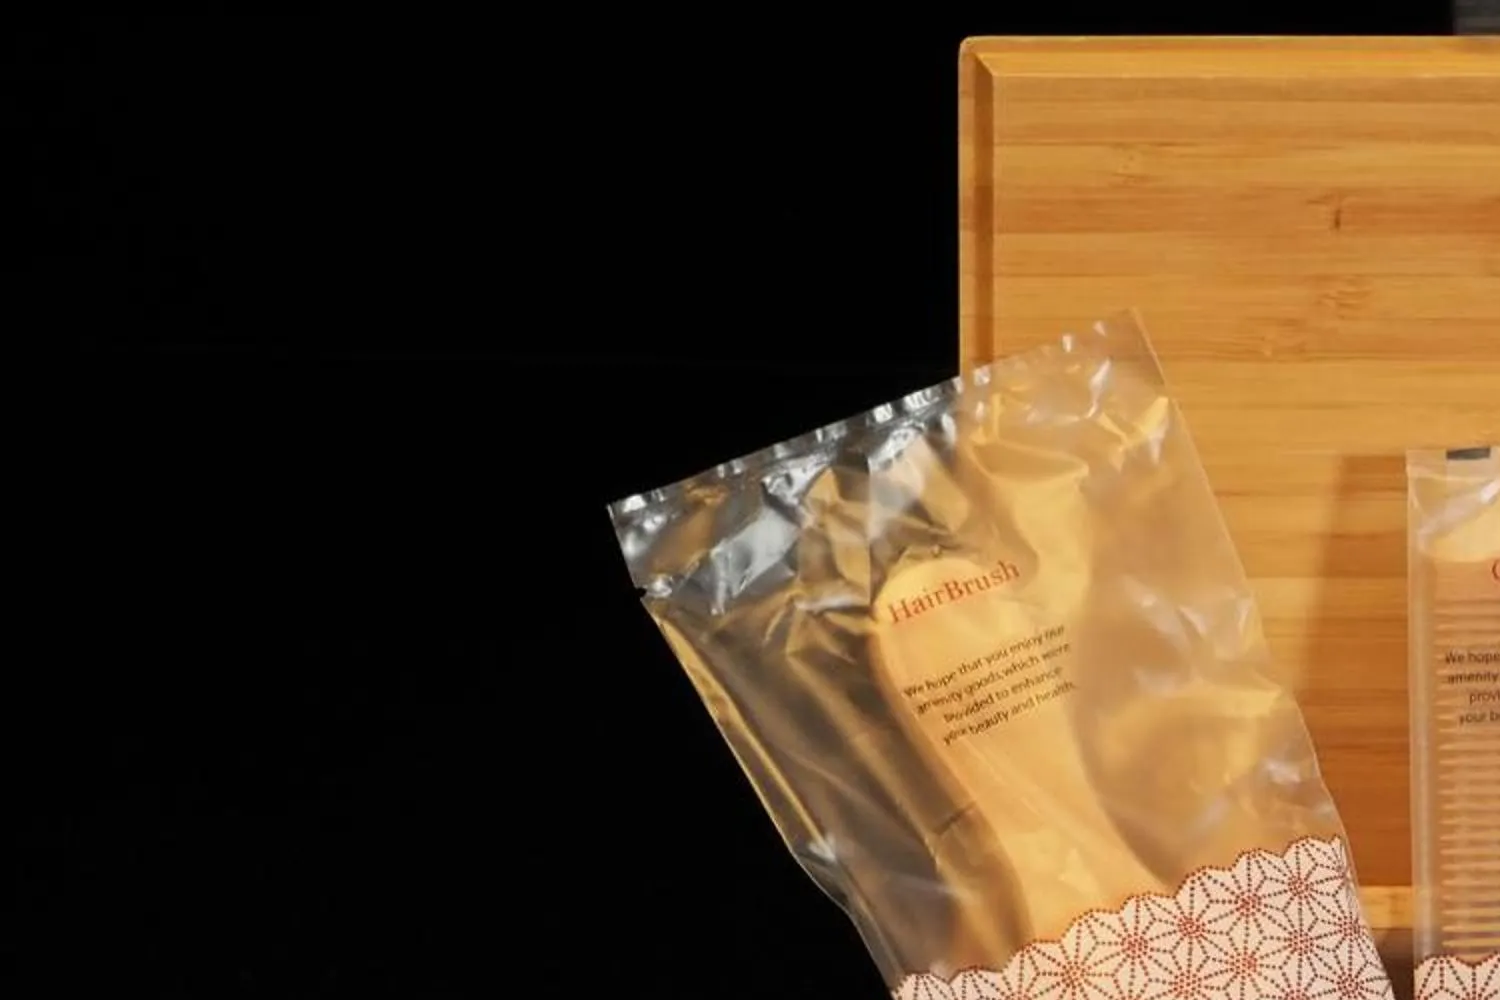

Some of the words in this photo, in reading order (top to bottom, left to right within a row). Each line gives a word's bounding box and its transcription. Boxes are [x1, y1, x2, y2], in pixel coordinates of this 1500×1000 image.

[888, 559, 1020, 625] HairBrush
[925, 671, 957, 692] hope
[958, 658, 983, 675] that
[986, 648, 1007, 666] you
[1009, 636, 1043, 655] enjoy
[1042, 643, 1070, 660] were
[1467, 651, 1500, 666] hope
[996, 686, 1010, 701] to
[1011, 666, 1062, 694] enhance
[1448, 671, 1499, 685] amenity
[968, 709, 1010, 735] beauty
[1011, 699, 1035, 716] and
